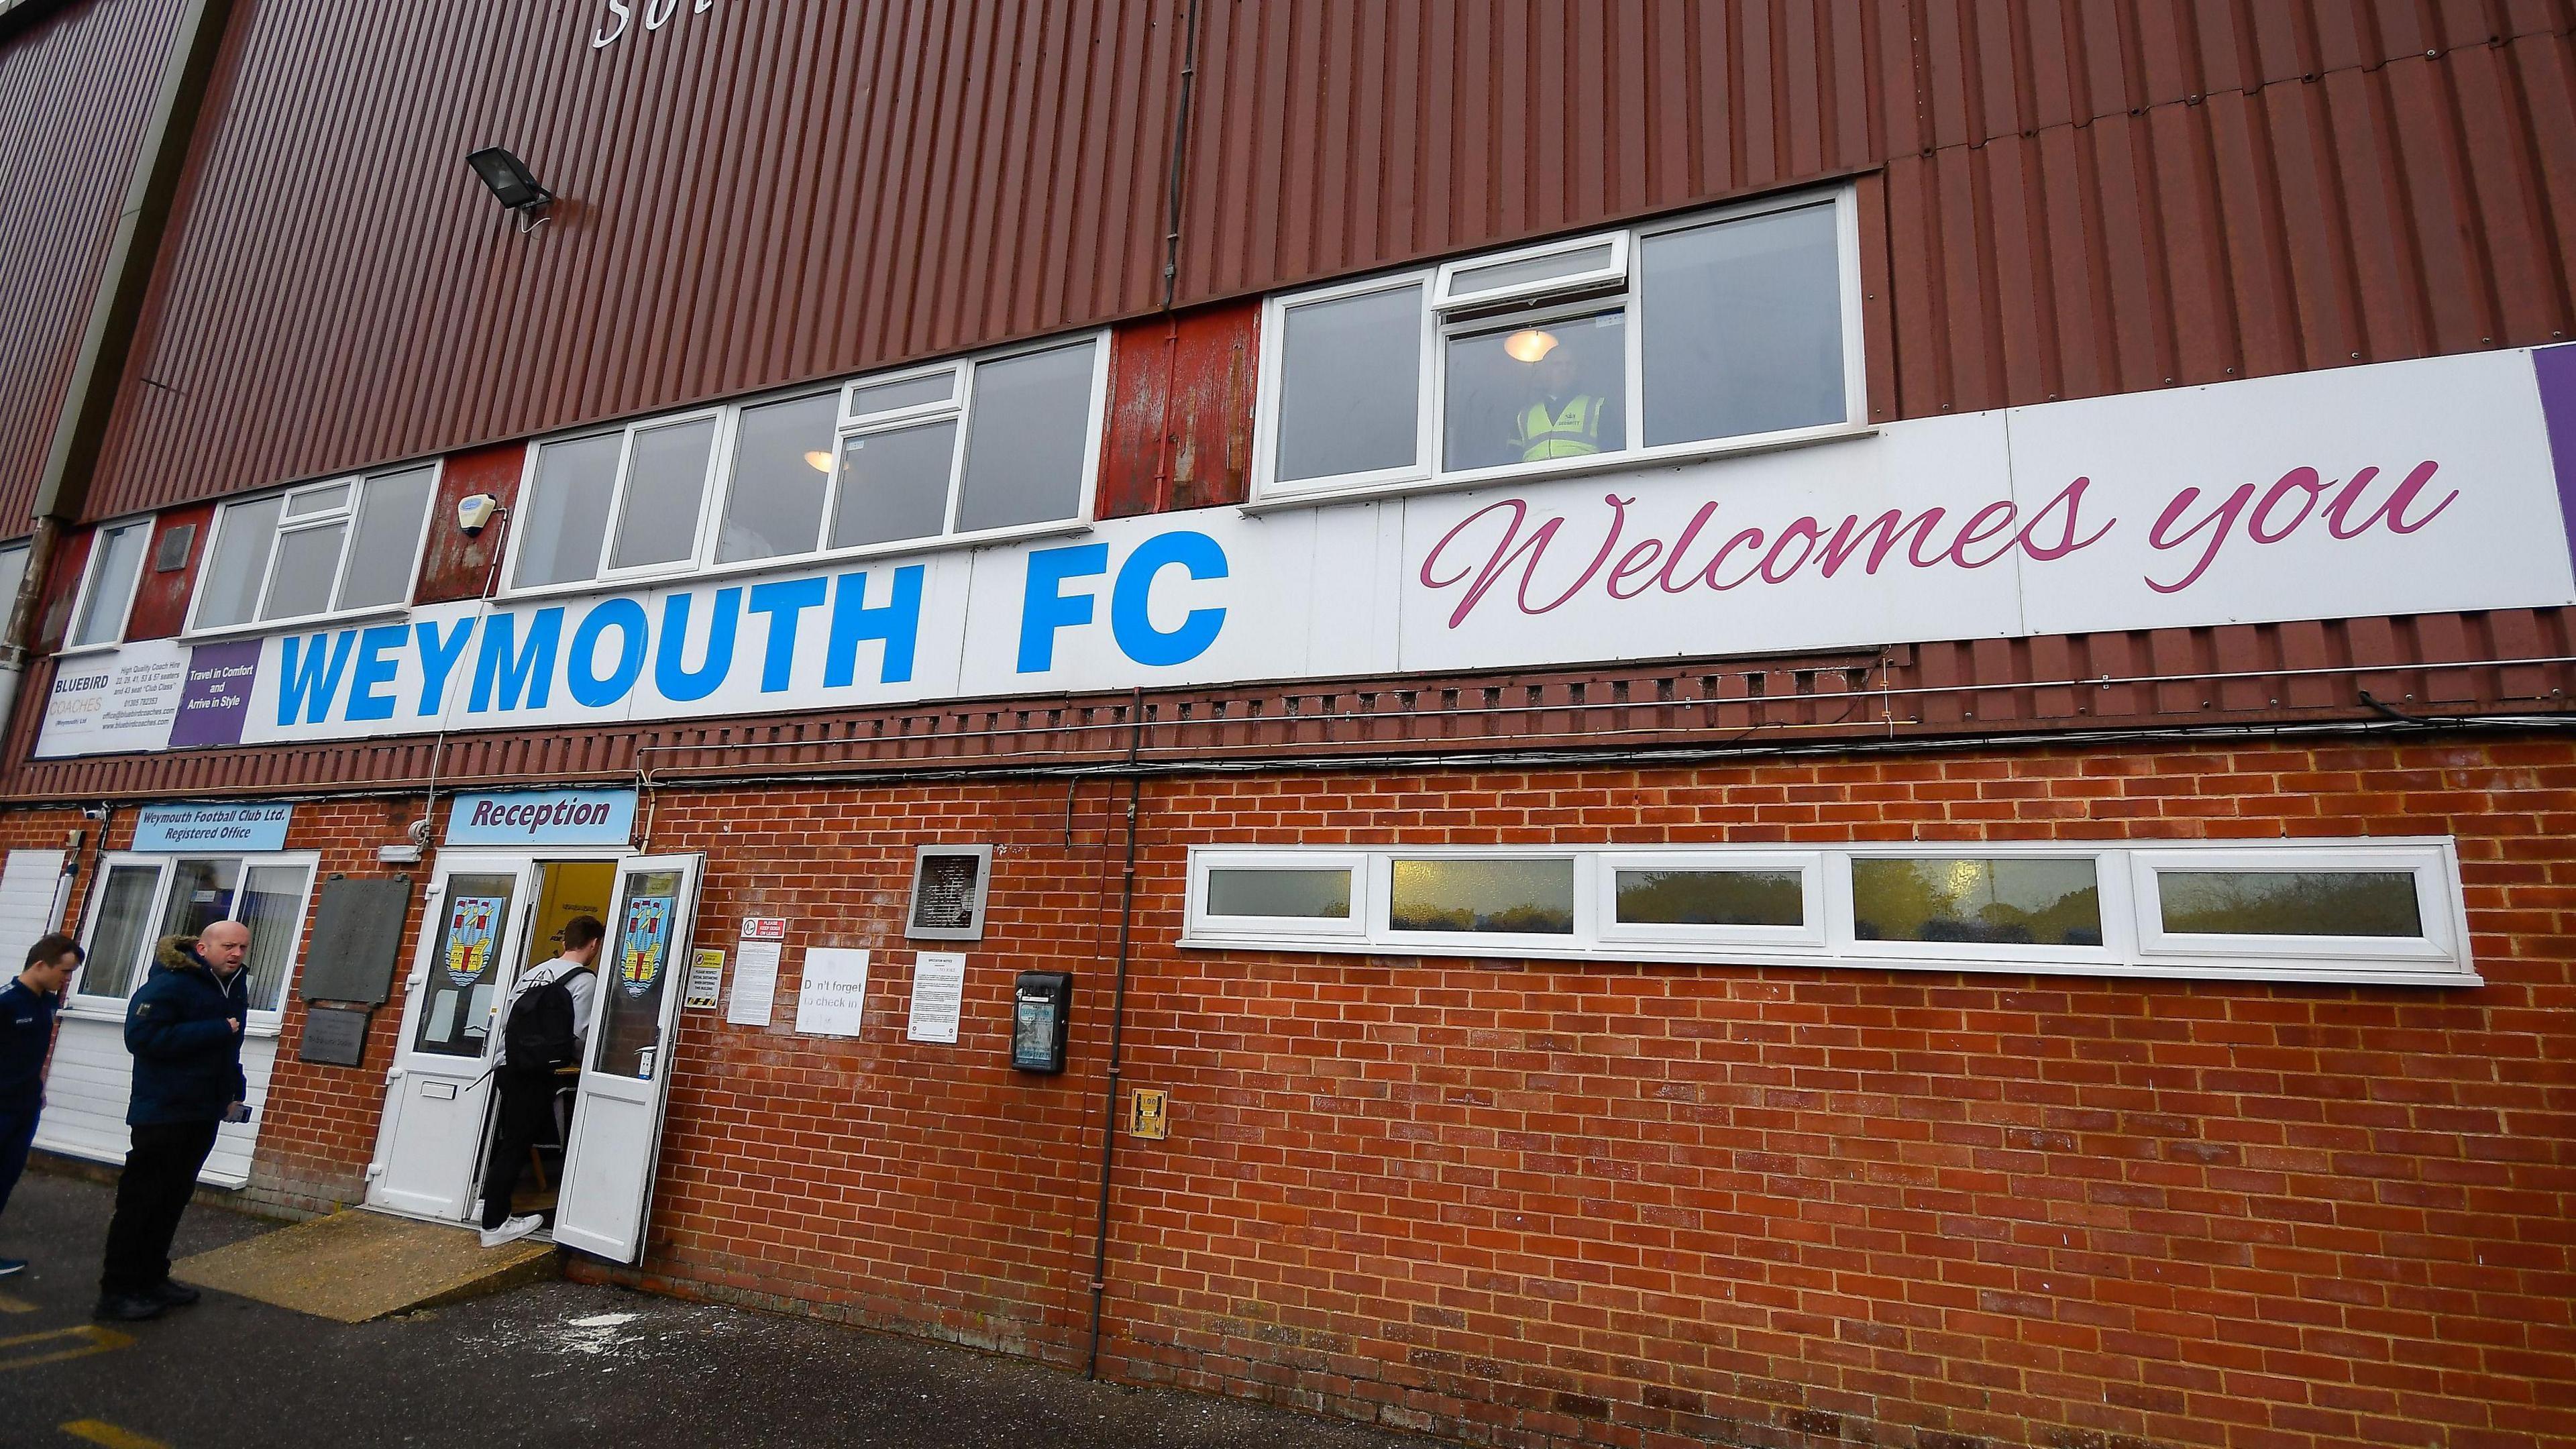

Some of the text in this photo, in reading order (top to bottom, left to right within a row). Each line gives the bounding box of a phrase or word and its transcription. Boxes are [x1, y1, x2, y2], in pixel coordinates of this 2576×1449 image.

[1419, 460, 2459, 630] Welcomes you
[276, 531, 1229, 727] WEYMOUTH FC
[133, 665, 151, 673] Quality
[152, 662, 168, 671] Coach
[169, 661, 180, 669] Hire
[190, 664, 254, 681] Travel in Comfort
[55, 675, 109, 693] BLUEBIRD
[209, 682, 226, 694] and
[50, 697, 102, 716] COACHES
[186, 695, 240, 710] Arrive in Style
[143, 808, 286, 827] Weymouth Football Club Ltd.
[470, 797, 610, 835] Reception
[165, 826, 252, 843] Registered Office
[804, 979, 861, 994] Dn't forget
[816, 996, 845, 1008] check
